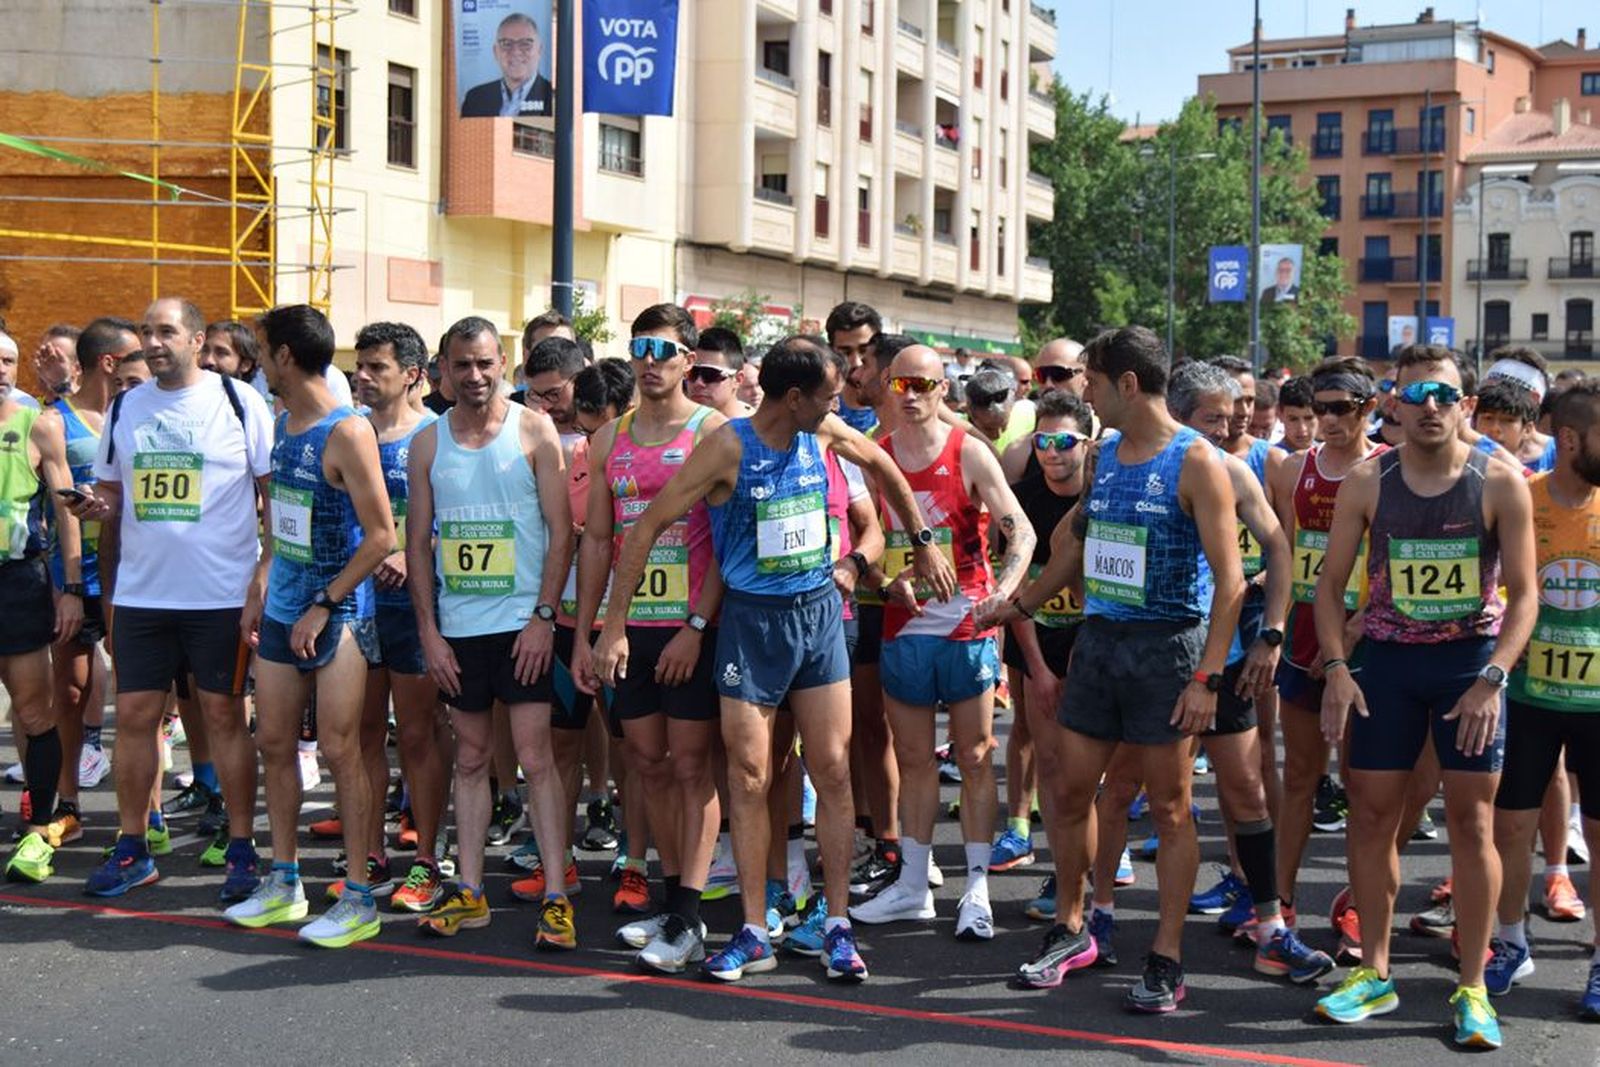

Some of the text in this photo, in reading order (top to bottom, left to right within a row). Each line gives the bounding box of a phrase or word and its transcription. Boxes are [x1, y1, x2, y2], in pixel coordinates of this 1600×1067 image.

[600, 18, 658, 38] VOTA
[141, 473, 190, 500] 150
[783, 528, 806, 550] FENI
[458, 543, 494, 571] 67
[1094, 554, 1135, 579] MARCOS
[461, 580, 510, 588] CAJA RURAL
[1400, 564, 1466, 595] 124
[1100, 585, 1141, 600] CAJA RURAL
[637, 605, 683, 614] CAJA RURAL
[1417, 603, 1475, 613] CAJA RURAL
[1541, 648, 1595, 680] 117
